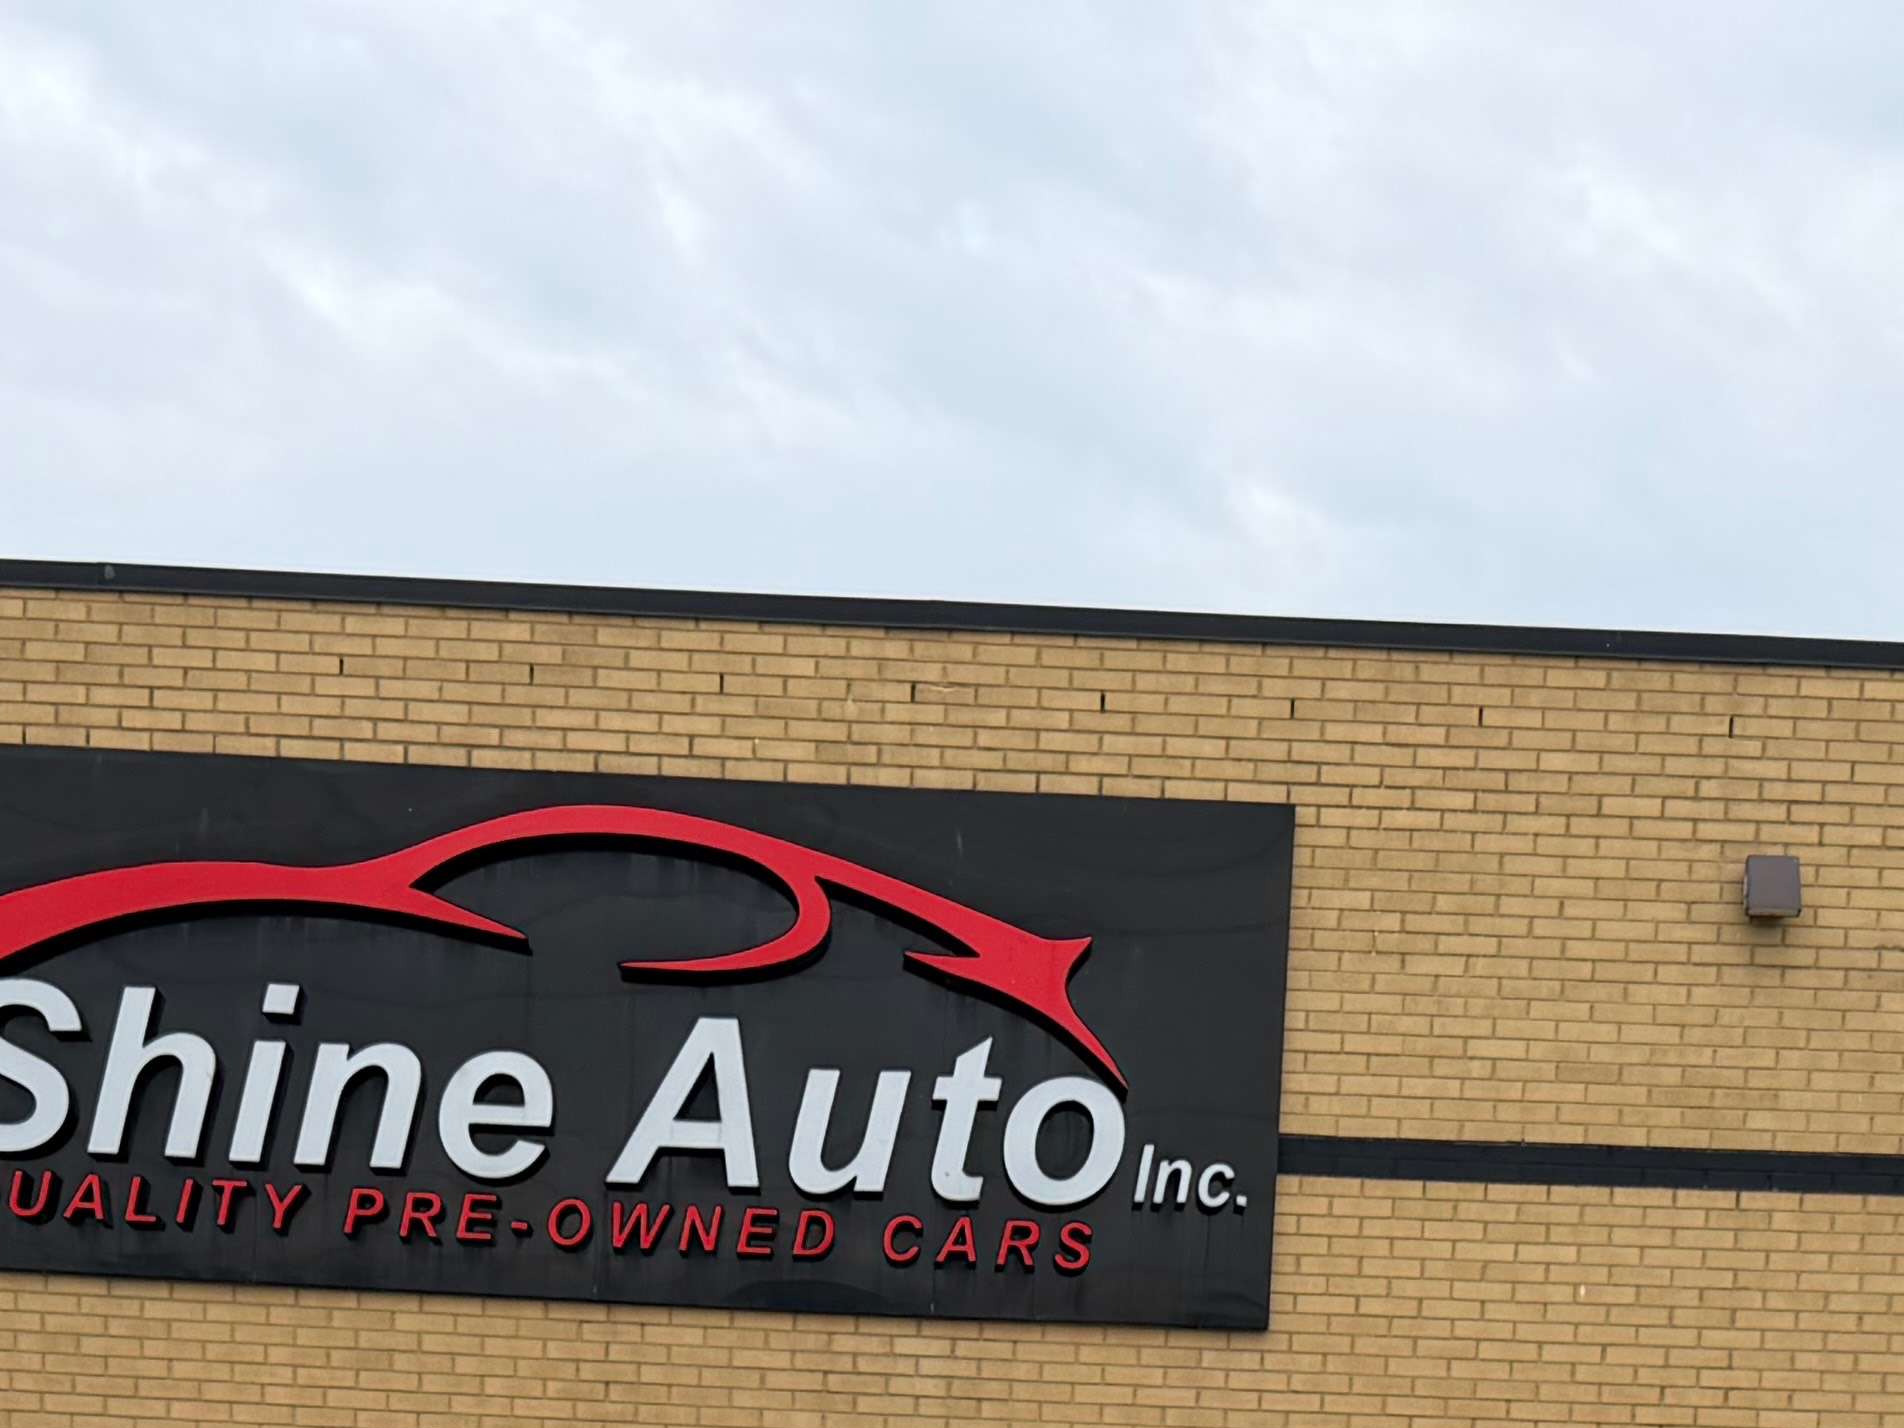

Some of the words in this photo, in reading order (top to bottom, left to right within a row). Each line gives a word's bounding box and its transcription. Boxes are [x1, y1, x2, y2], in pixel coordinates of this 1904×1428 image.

[604, 1016, 1127, 1206] Auto
[1133, 1143, 1249, 1209] Inc.
[343, 1186, 837, 1259] PRE-OWNED
[882, 1214, 1094, 1271] CARS
